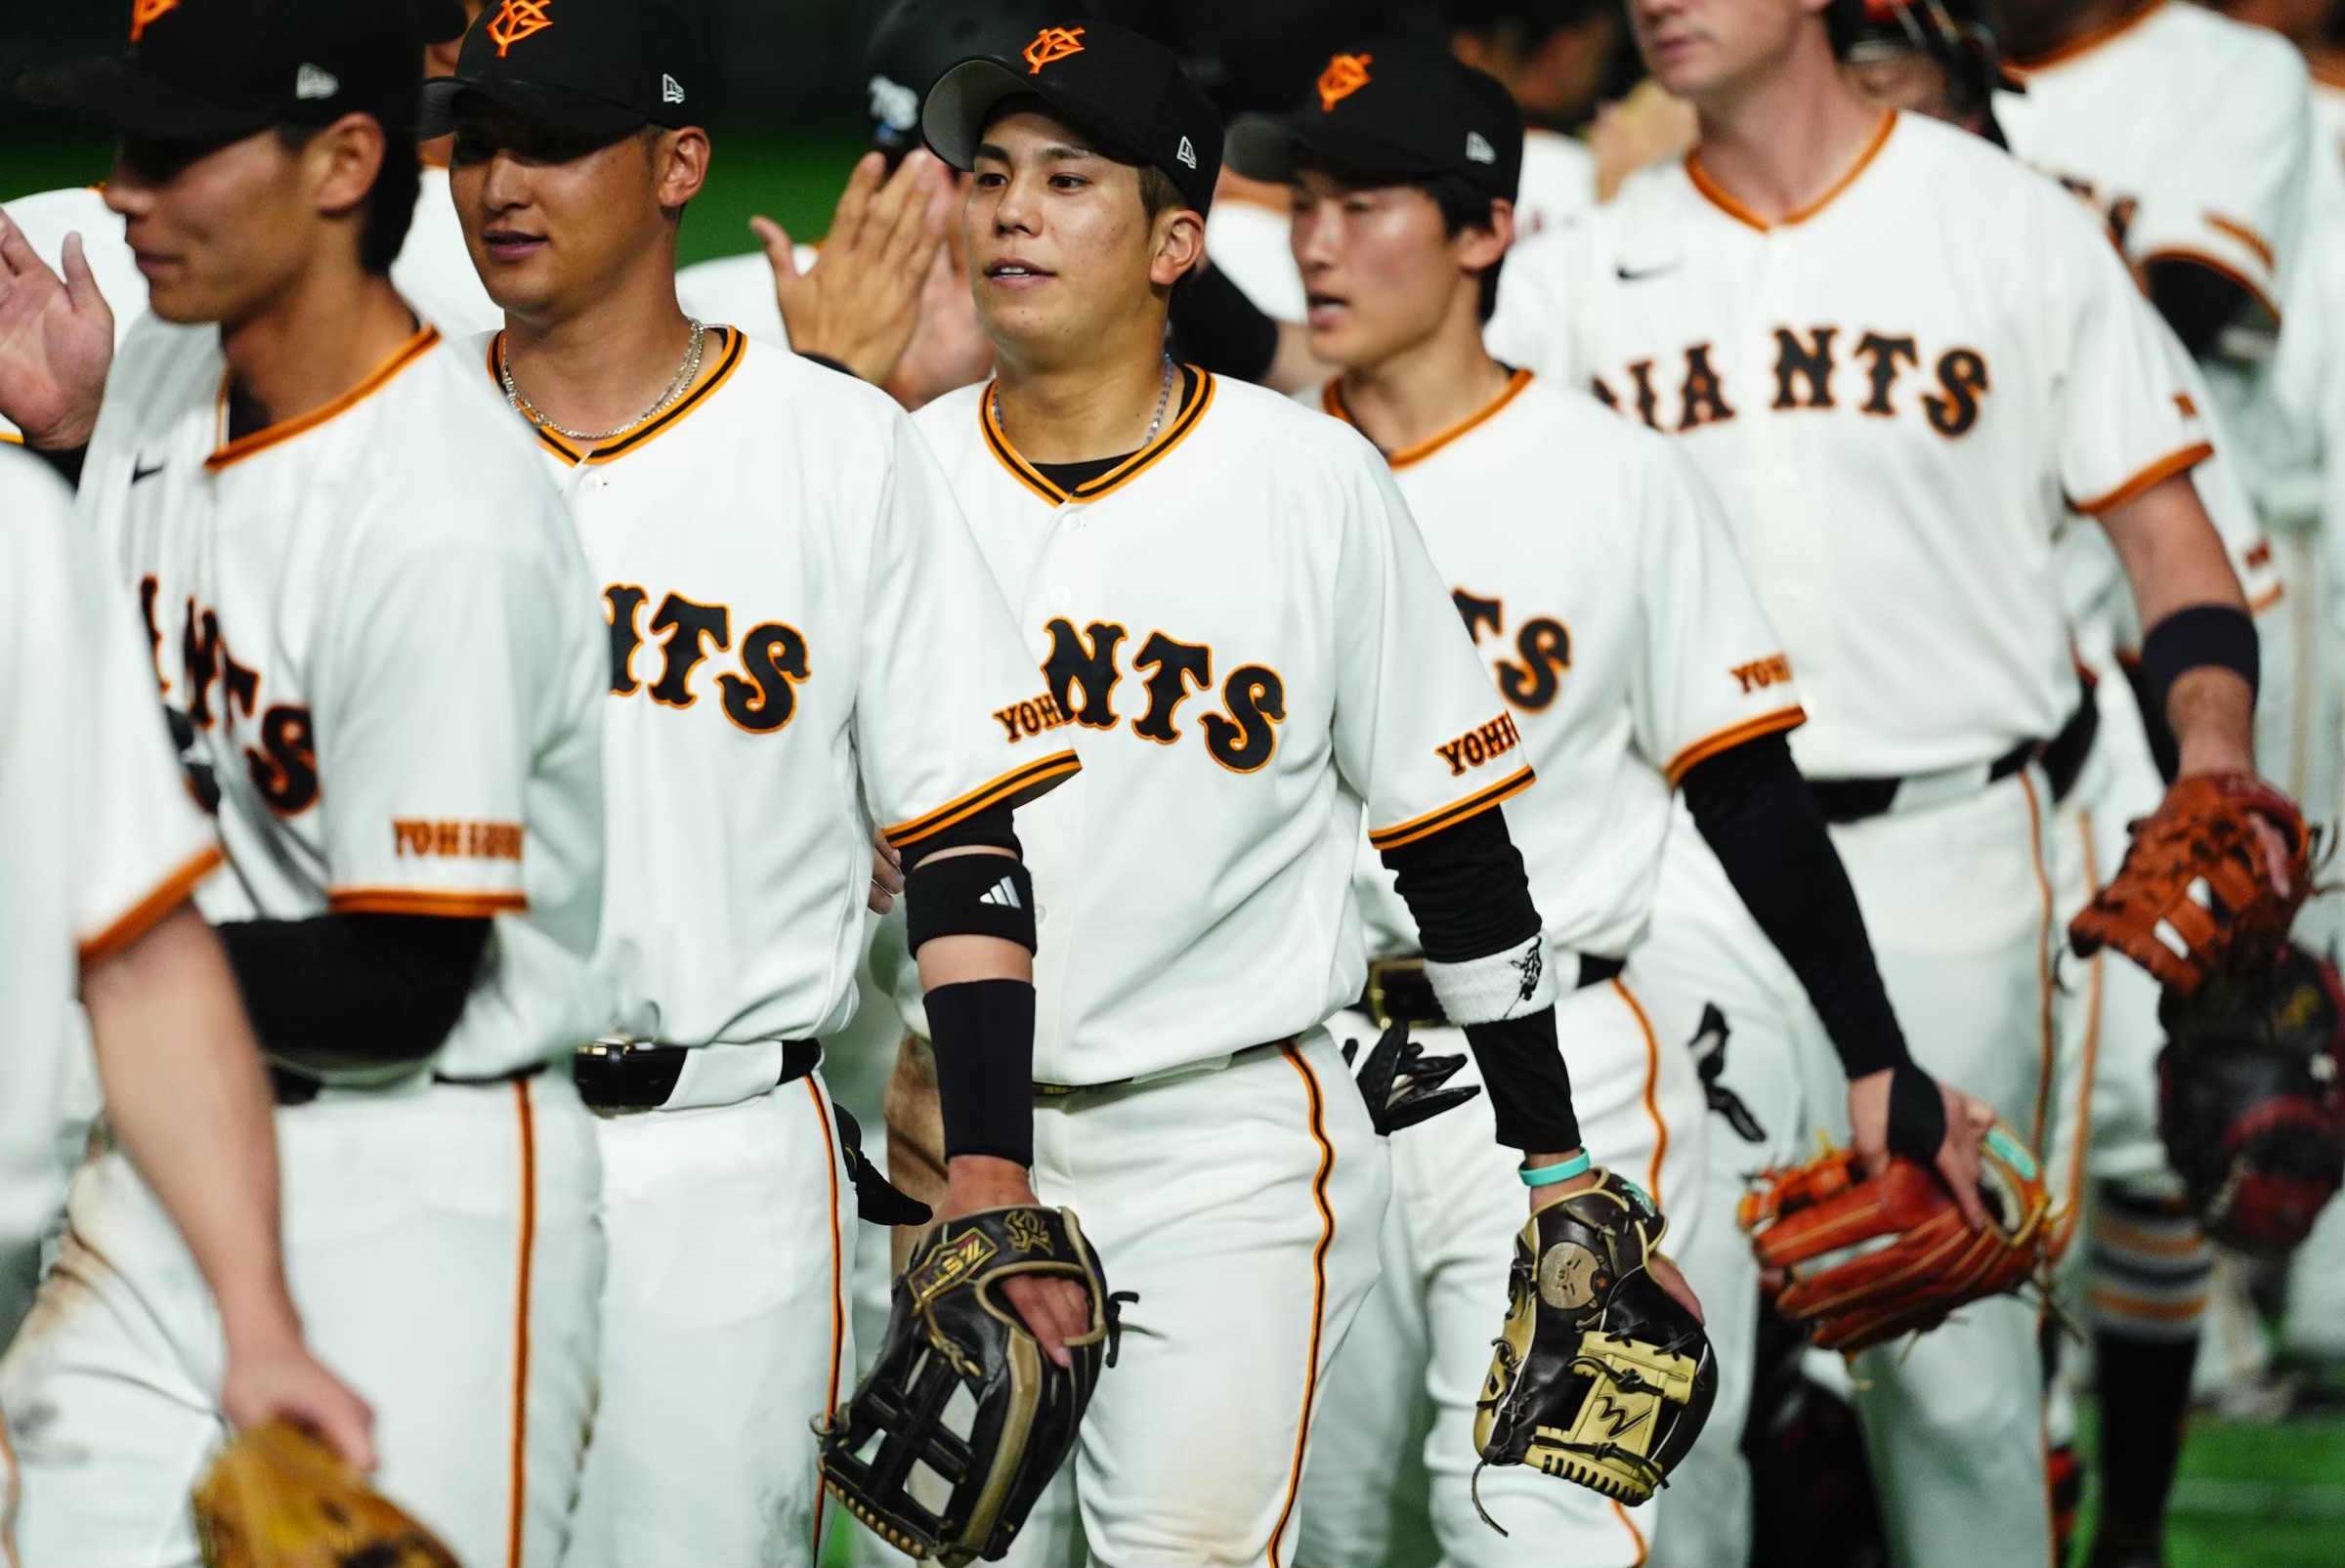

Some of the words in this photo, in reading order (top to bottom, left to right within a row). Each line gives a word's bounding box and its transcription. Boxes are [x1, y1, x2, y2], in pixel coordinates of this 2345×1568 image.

[1592, 326, 1991, 441] IANTS
[1435, 710, 1520, 776] YOMI
[919, 1237, 987, 1299] ZETT
